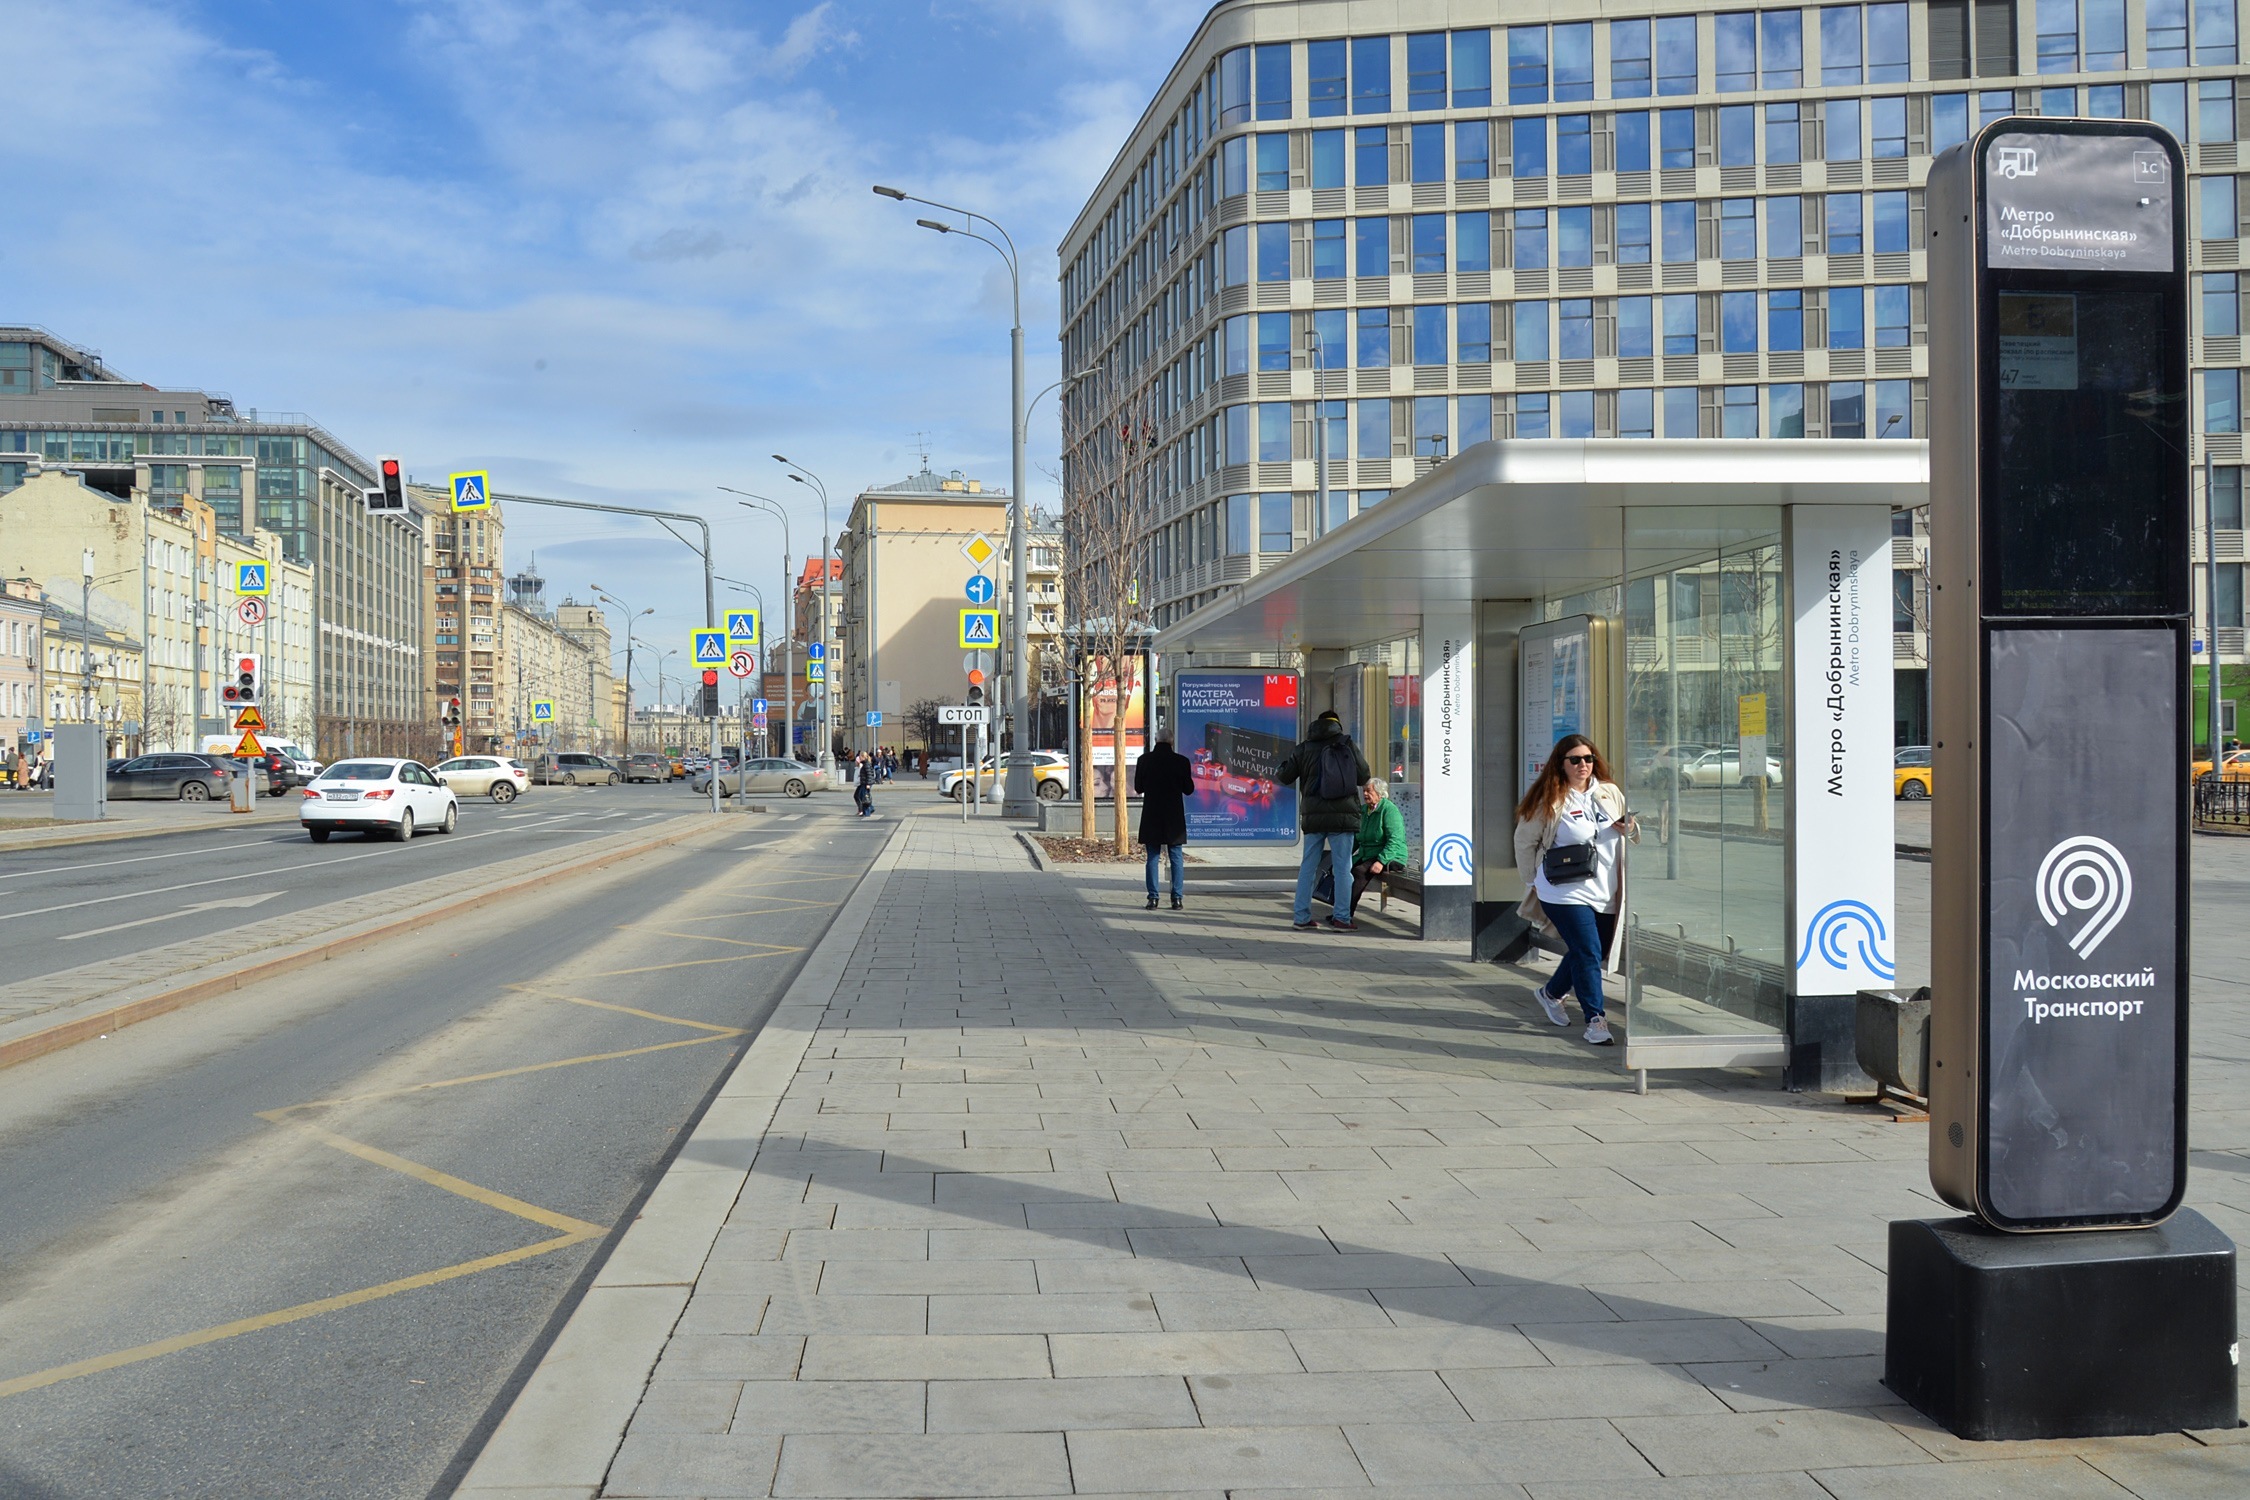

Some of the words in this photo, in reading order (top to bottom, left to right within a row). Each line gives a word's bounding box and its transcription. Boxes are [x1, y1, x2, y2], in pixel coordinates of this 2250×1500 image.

[2001, 206, 2054, 224] Метро
[2001, 224, 2138, 242] «Добрынинская»
[2001, 245, 2038, 256] Metro
[2041, 246, 2127, 259] Dobryninskaya
[2000, 369, 2019, 384] 47
[1847, 549, 1861, 643] Dobryninskaya
[1825, 549, 1845, 722] «Добрынинская»
[1453, 639, 1461, 691] Dobryninskaya
[1848, 647, 1860, 687] Metro
[1182, 690, 1234, 698] МАСТЕРА
[1441, 639, 1452, 735] «Добрынинская»
[1182, 699, 1190, 707] И
[1192, 699, 1260, 707] МАРГАРИТЫ
[945, 709, 983, 721] СТОП
[1237, 744, 1272, 760] МАСТЕР
[1441, 738, 1452, 776] Метро
[1827, 728, 1846, 797] Метро
[1227, 783, 1247, 794] KION
[1280, 827, 1295, 836] 18+
[2013, 966, 2155, 991] Московский
[2024, 997, 2144, 1024] Транспорт
